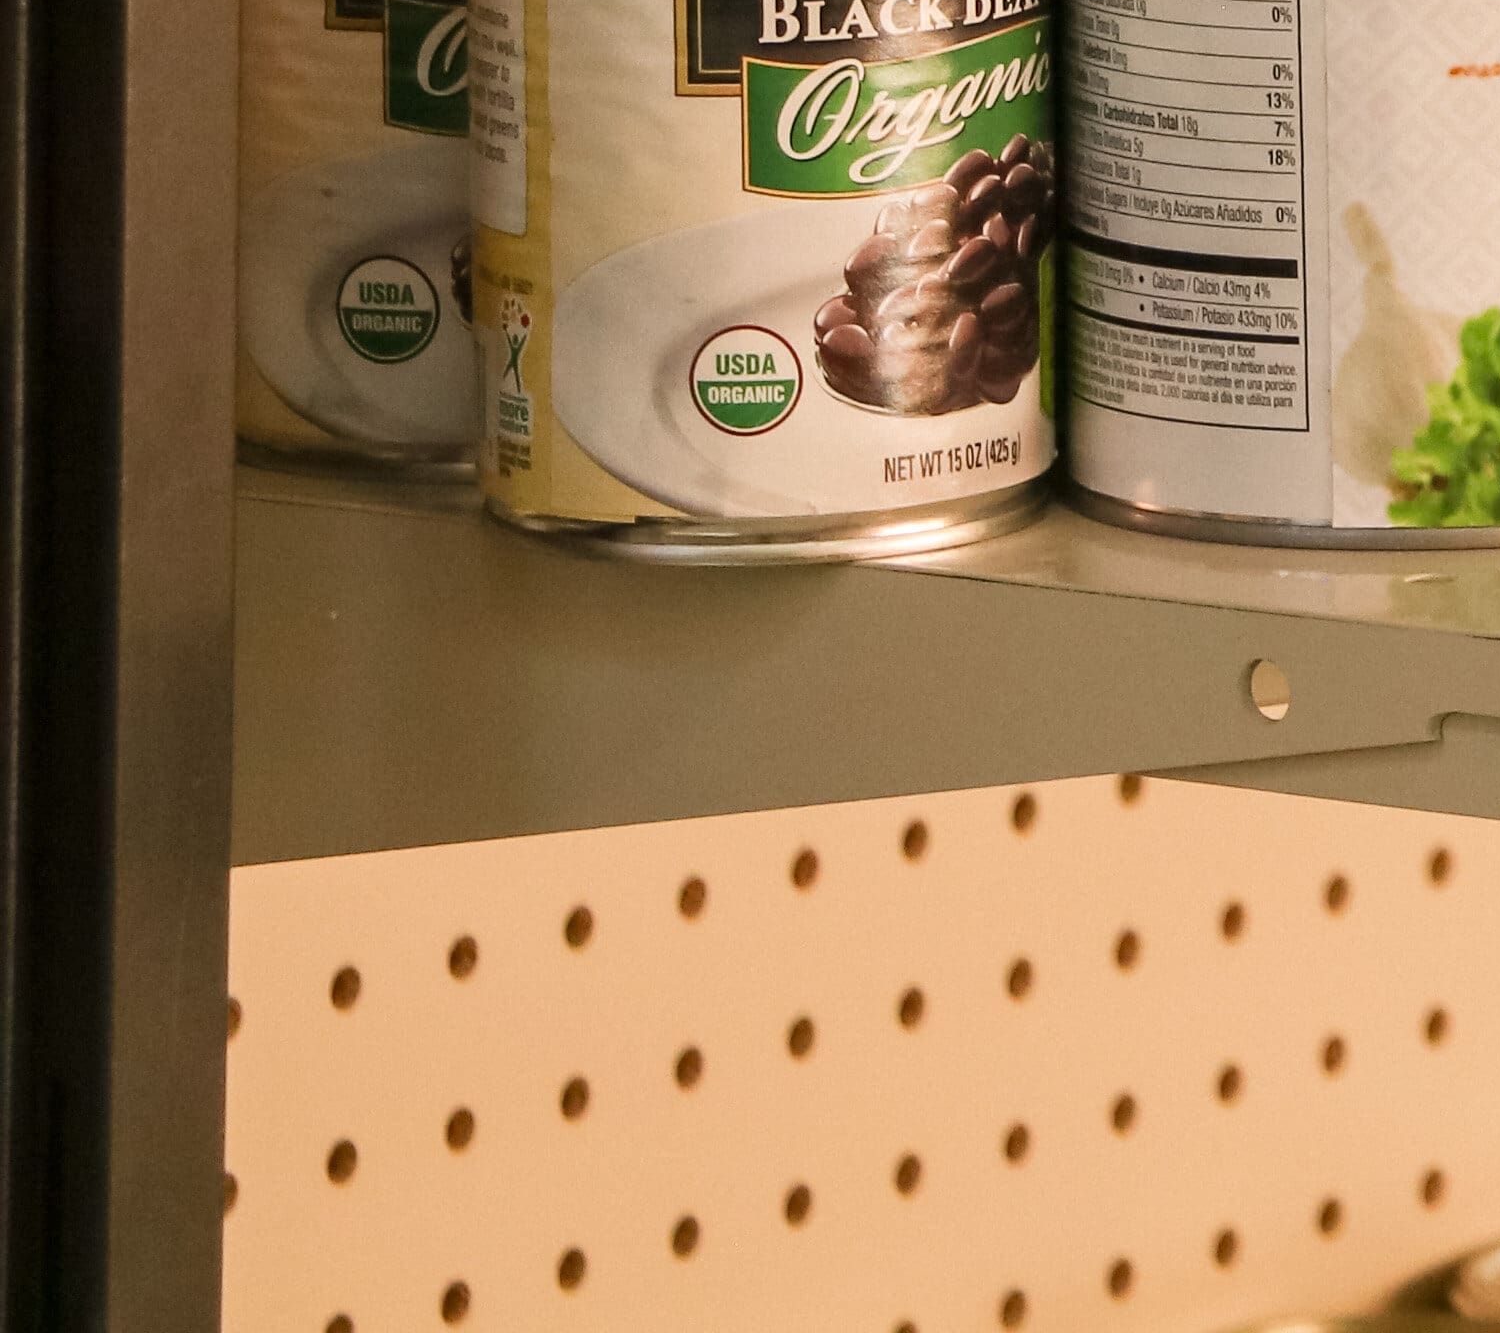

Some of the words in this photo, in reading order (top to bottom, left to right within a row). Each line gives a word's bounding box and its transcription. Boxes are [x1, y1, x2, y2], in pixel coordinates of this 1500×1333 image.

[1272, 7, 1292, 24] 0%
[1272, 64, 1293, 81] 0%
[776, 31, 1050, 185] Organic
[1266, 93, 1294, 109] 13%
[1275, 122, 1294, 137] 7%
[1268, 150, 1295, 166] 18%
[1174, 199, 1215, 219] Azúcares
[1217, 204, 1263, 223] Añadidos
[1275, 207, 1296, 223] 0%
[358, 281, 415, 306] USDA
[1223, 280, 1250, 301] 43mg
[351, 314, 422, 334] ORGANIC
[1237, 311, 1271, 332] 433mg
[1275, 312, 1297, 329] 10%
[715, 353, 777, 377] USDA
[707, 385, 785, 406] ORGANIC
[883, 456, 914, 483] NET
[918, 451, 942, 479] WT
[946, 448, 962, 474] 15
[967, 443, 983, 471] OZ
